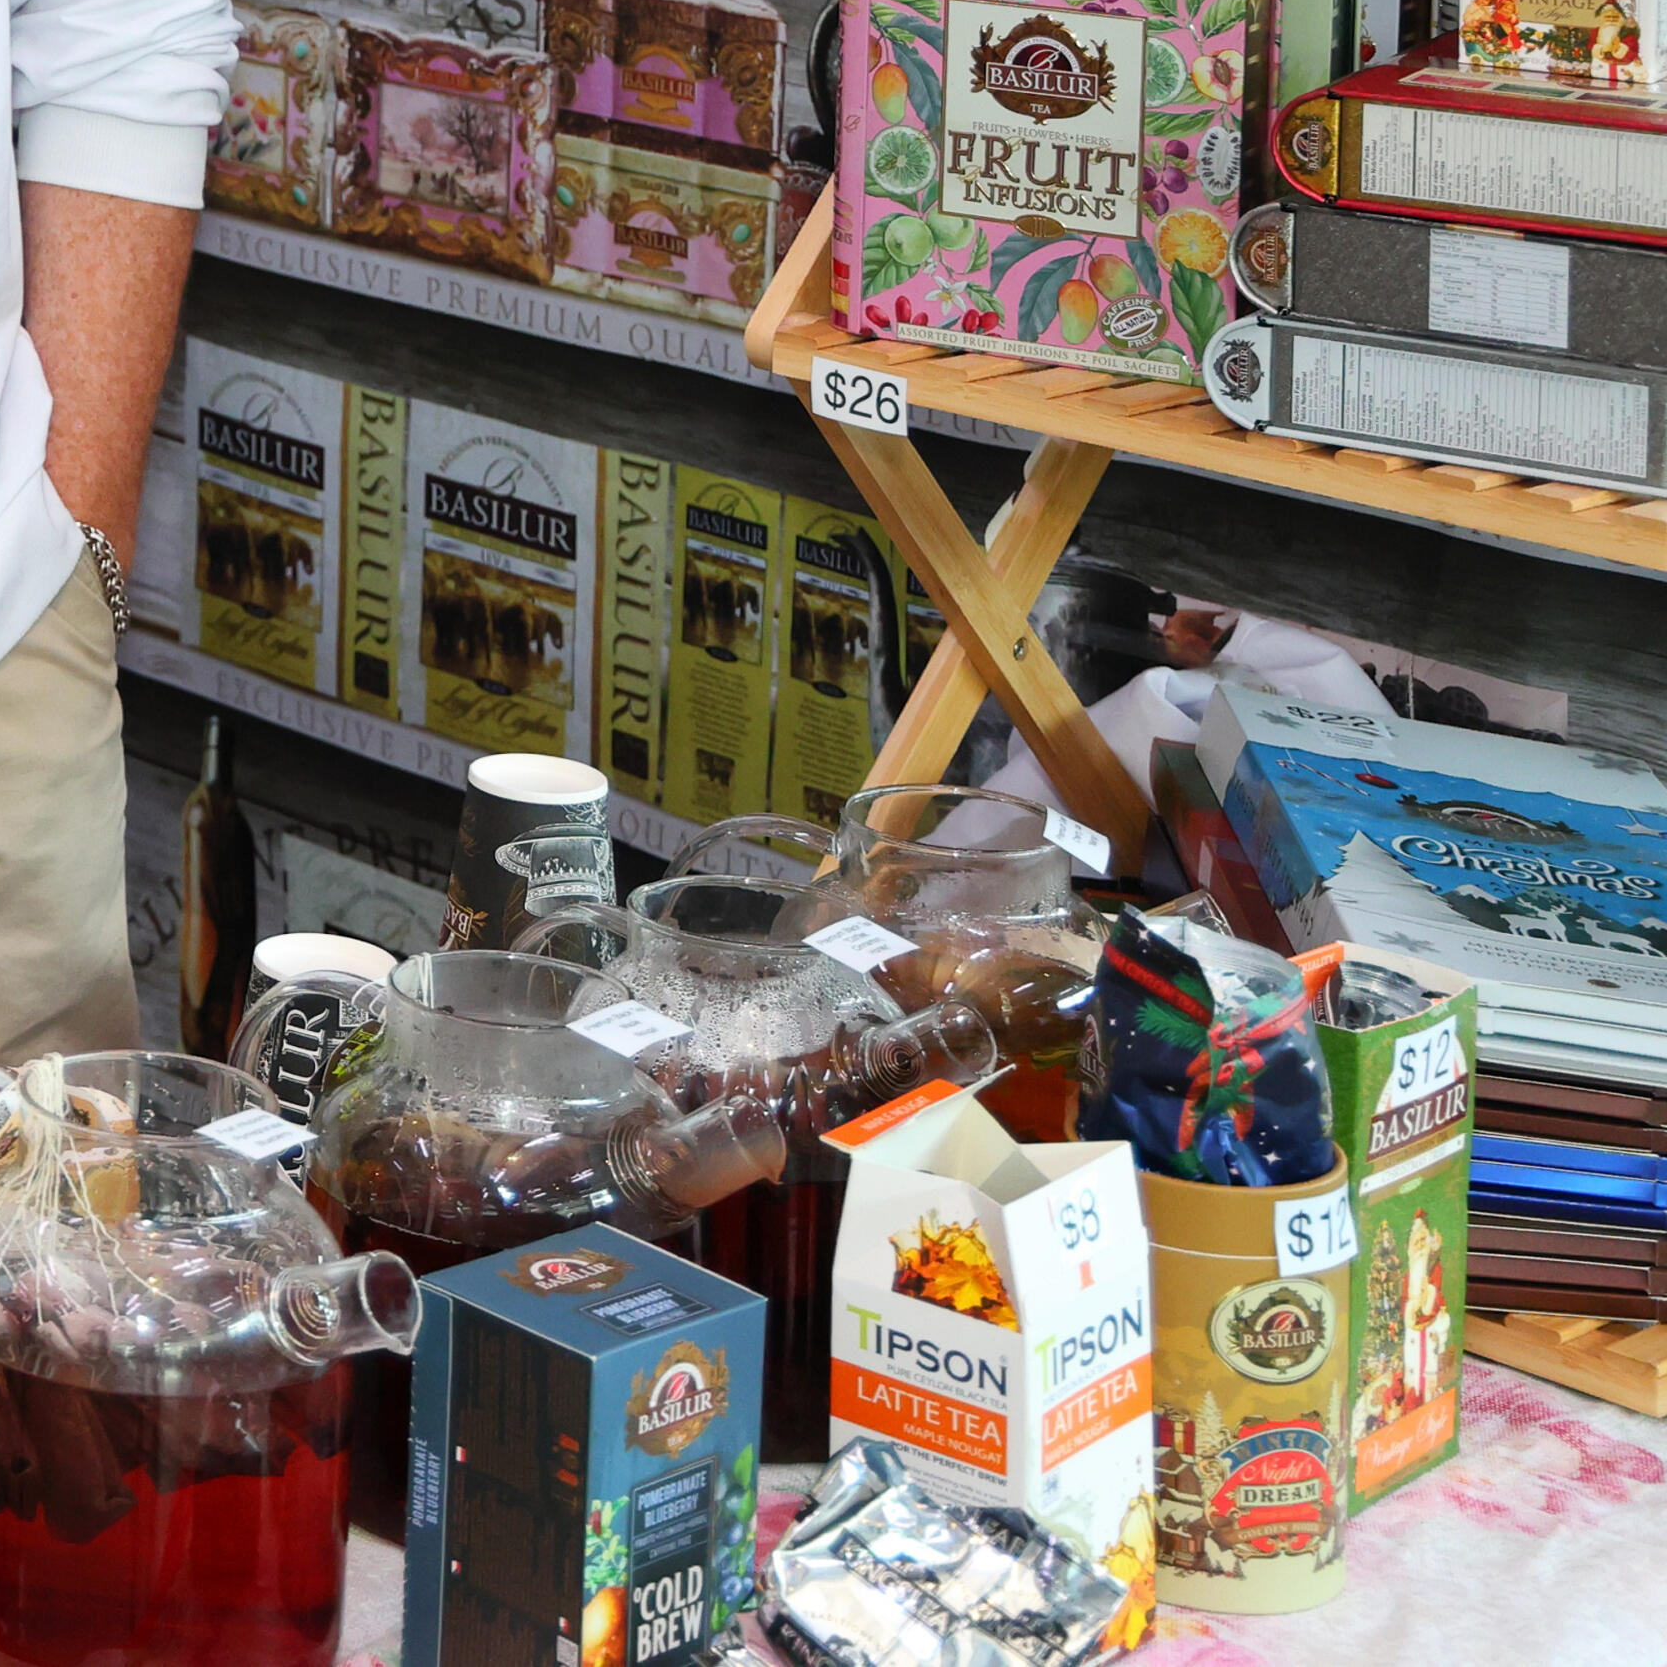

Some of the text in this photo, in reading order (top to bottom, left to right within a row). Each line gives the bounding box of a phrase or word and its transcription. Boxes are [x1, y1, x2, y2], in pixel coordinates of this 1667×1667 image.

[622, 68, 696, 103] BASILUR
[989, 66, 1094, 97] BASILUR
[1030, 102, 1052, 115] TEA
[972, 121, 1112, 147] FRUITS FLOWERS HERBS
[947, 130, 1136, 196] FRUIT
[963, 180, 1117, 221] INFUSIONS
[218, 225, 403, 299] EXCLUSIVE
[425, 275, 604, 346] PREMIUM
[1101, 297, 1154, 327] CAFFEINE
[898, 324, 1180, 377] ASSORTED FRUIT INFUSIONS 32 FOIL SACHETS
[1127, 333, 1158, 349] FREE
[823, 368, 901, 426] $26
[200, 414, 322, 486] BASILUR
[355, 388, 396, 648] BASILUR
[425, 479, 574, 553] BASILUR
[689, 507, 765, 547] BASILUR
[610, 453, 661, 729] BASILUR
[214, 669, 399, 765] EXCLUSIVE
[1285, 705, 1378, 728] $22
[1391, 833, 1659, 900] Christmas
[1396, 1039, 1451, 1093] $12
[1368, 1080, 1468, 1154] BASILUR
[1059, 1187, 1102, 1251] $8
[1285, 1196, 1354, 1263] $12
[537, 1259, 614, 1293] BASILUR
[846, 1303, 1008, 1398] TIPSON
[1034, 1298, 1144, 1394] TIPSON
[1241, 1329, 1317, 1351] BASILUR
[637, 1389, 714, 1435] BASILUR
[856, 1375, 1003, 1448] LATTE TEA
[886, 1362, 1008, 1412] PURE CEYLON BLACK TEA
[1043, 1371, 1139, 1446] LATTE TEA
[903, 1422, 1004, 1467] MAPLE NOUGAT
[1226, 1428, 1329, 1464] WINTER
[411, 1435, 430, 1529] POMEGRANATE
[424, 1452, 442, 1527] BLUEBERRY
[637, 1471, 709, 1513] POMEGRANATE
[1241, 1481, 1319, 1504] DREAM
[644, 1493, 700, 1529] BLUEBERRY
[636, 1599, 706, 1664] BREW
